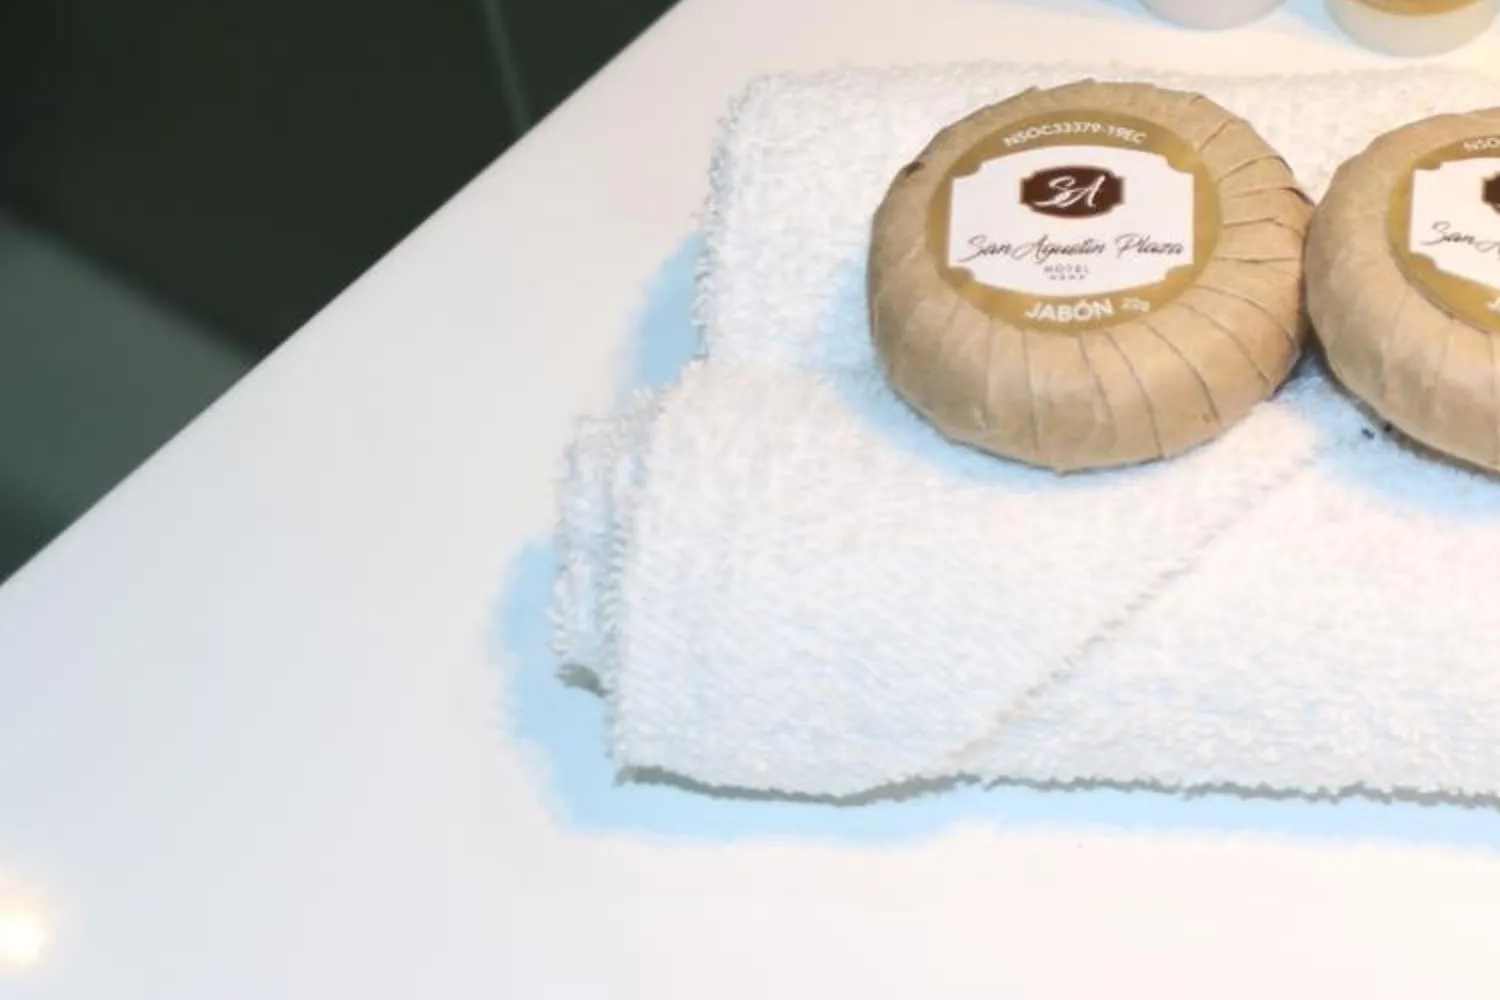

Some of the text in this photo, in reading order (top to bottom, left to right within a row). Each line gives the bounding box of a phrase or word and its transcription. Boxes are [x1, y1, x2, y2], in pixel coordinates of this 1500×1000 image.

[1419, 220, 1476, 246] San
[958, 233, 1012, 263] San
[1114, 232, 1186, 259] Plaza
[1043, 263, 1090, 274] HOTEL
